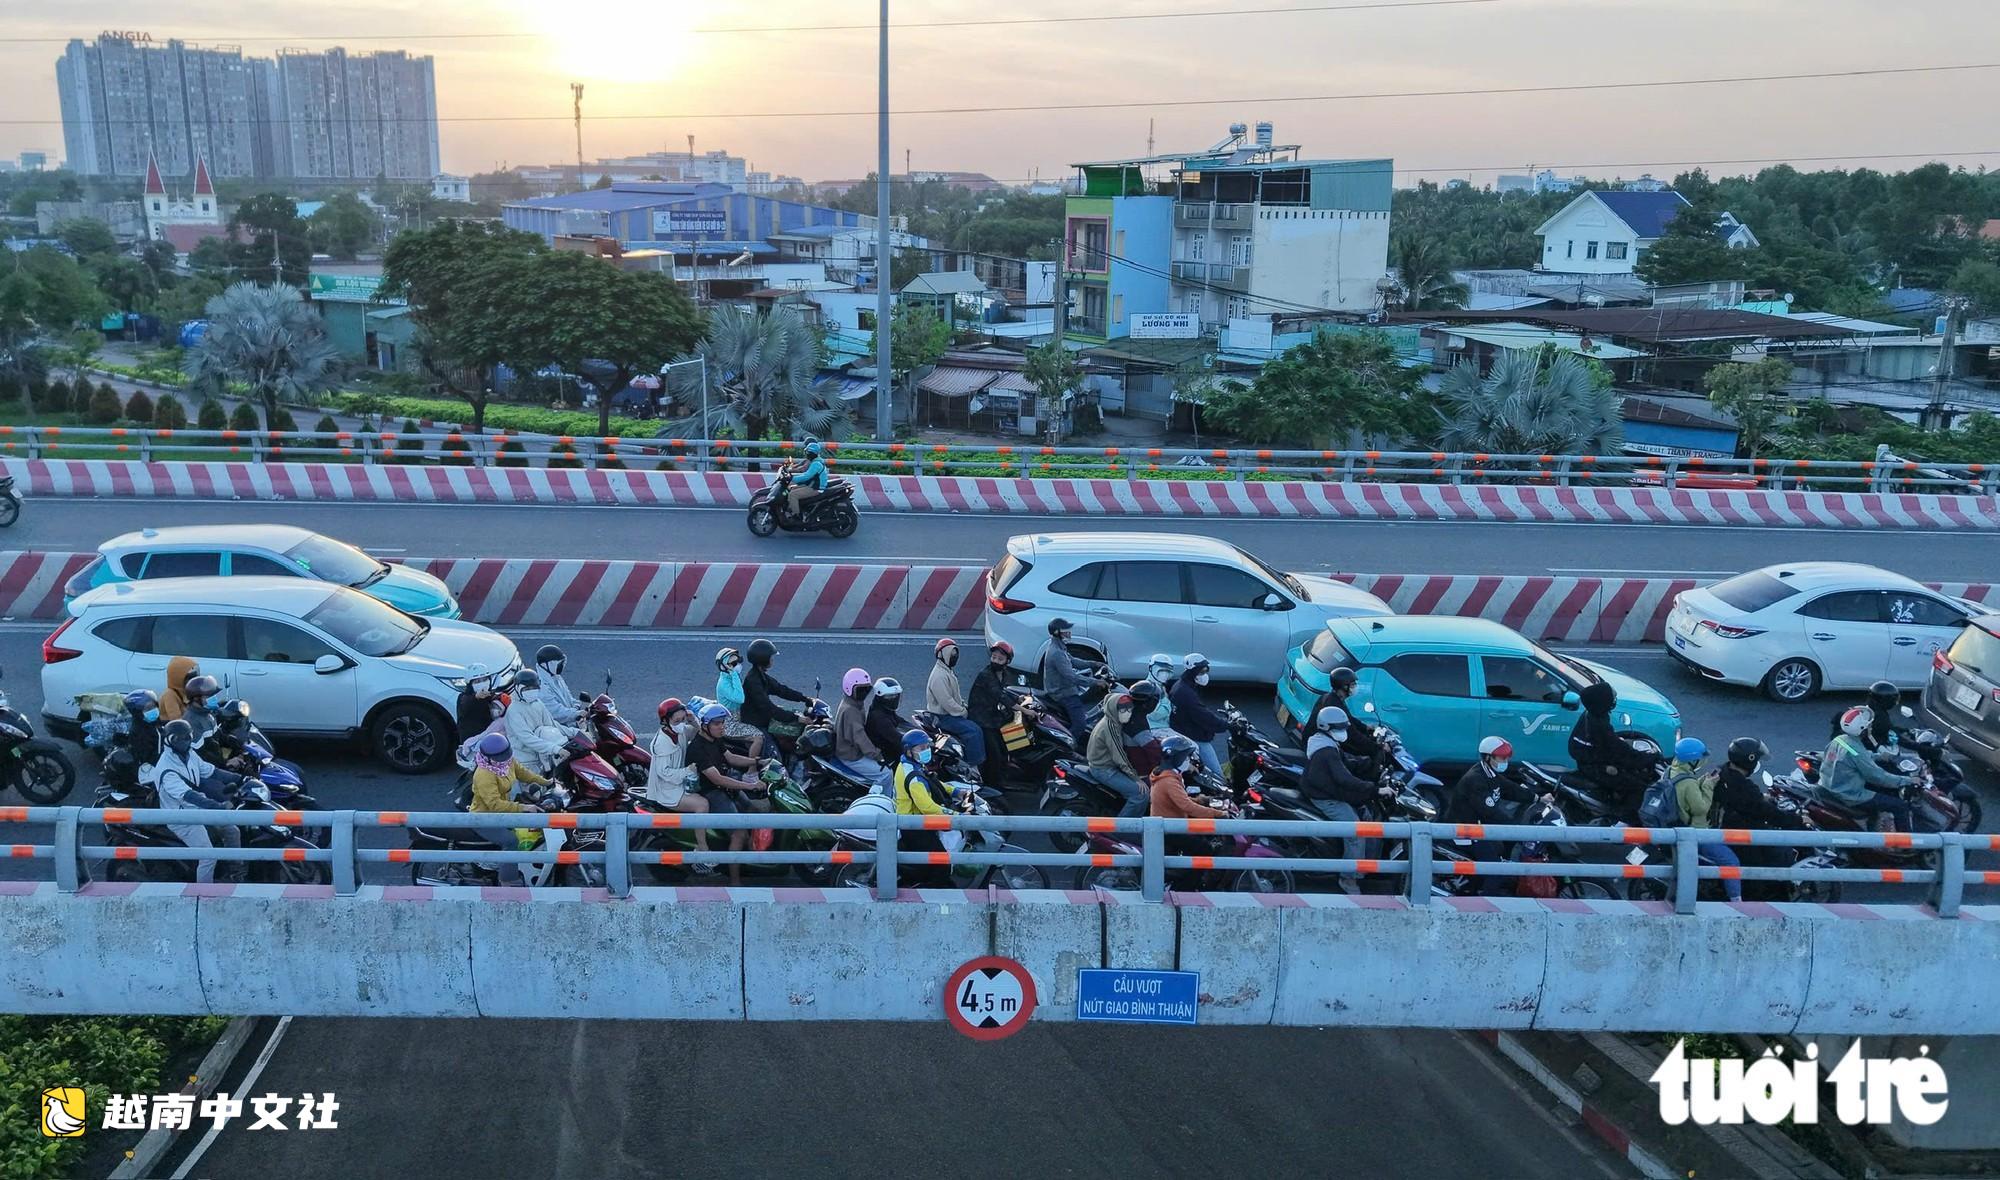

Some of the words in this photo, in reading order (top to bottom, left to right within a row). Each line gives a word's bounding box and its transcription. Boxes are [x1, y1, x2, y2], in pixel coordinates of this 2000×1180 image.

[1667, 448, 1691, 457] THANH
[960, 979, 994, 1014] 4,5
[1001, 994, 1017, 1012] m
[1113, 974, 1134, 994] CẦU
[1136, 979, 1162, 996] VƯỢT
[1083, 996, 1104, 1014] NÚT
[1106, 1001, 1129, 1015] GIAO
[1131, 1000, 1155, 1016] BÌNH
[1158, 1003, 1192, 1020] THUẬN
